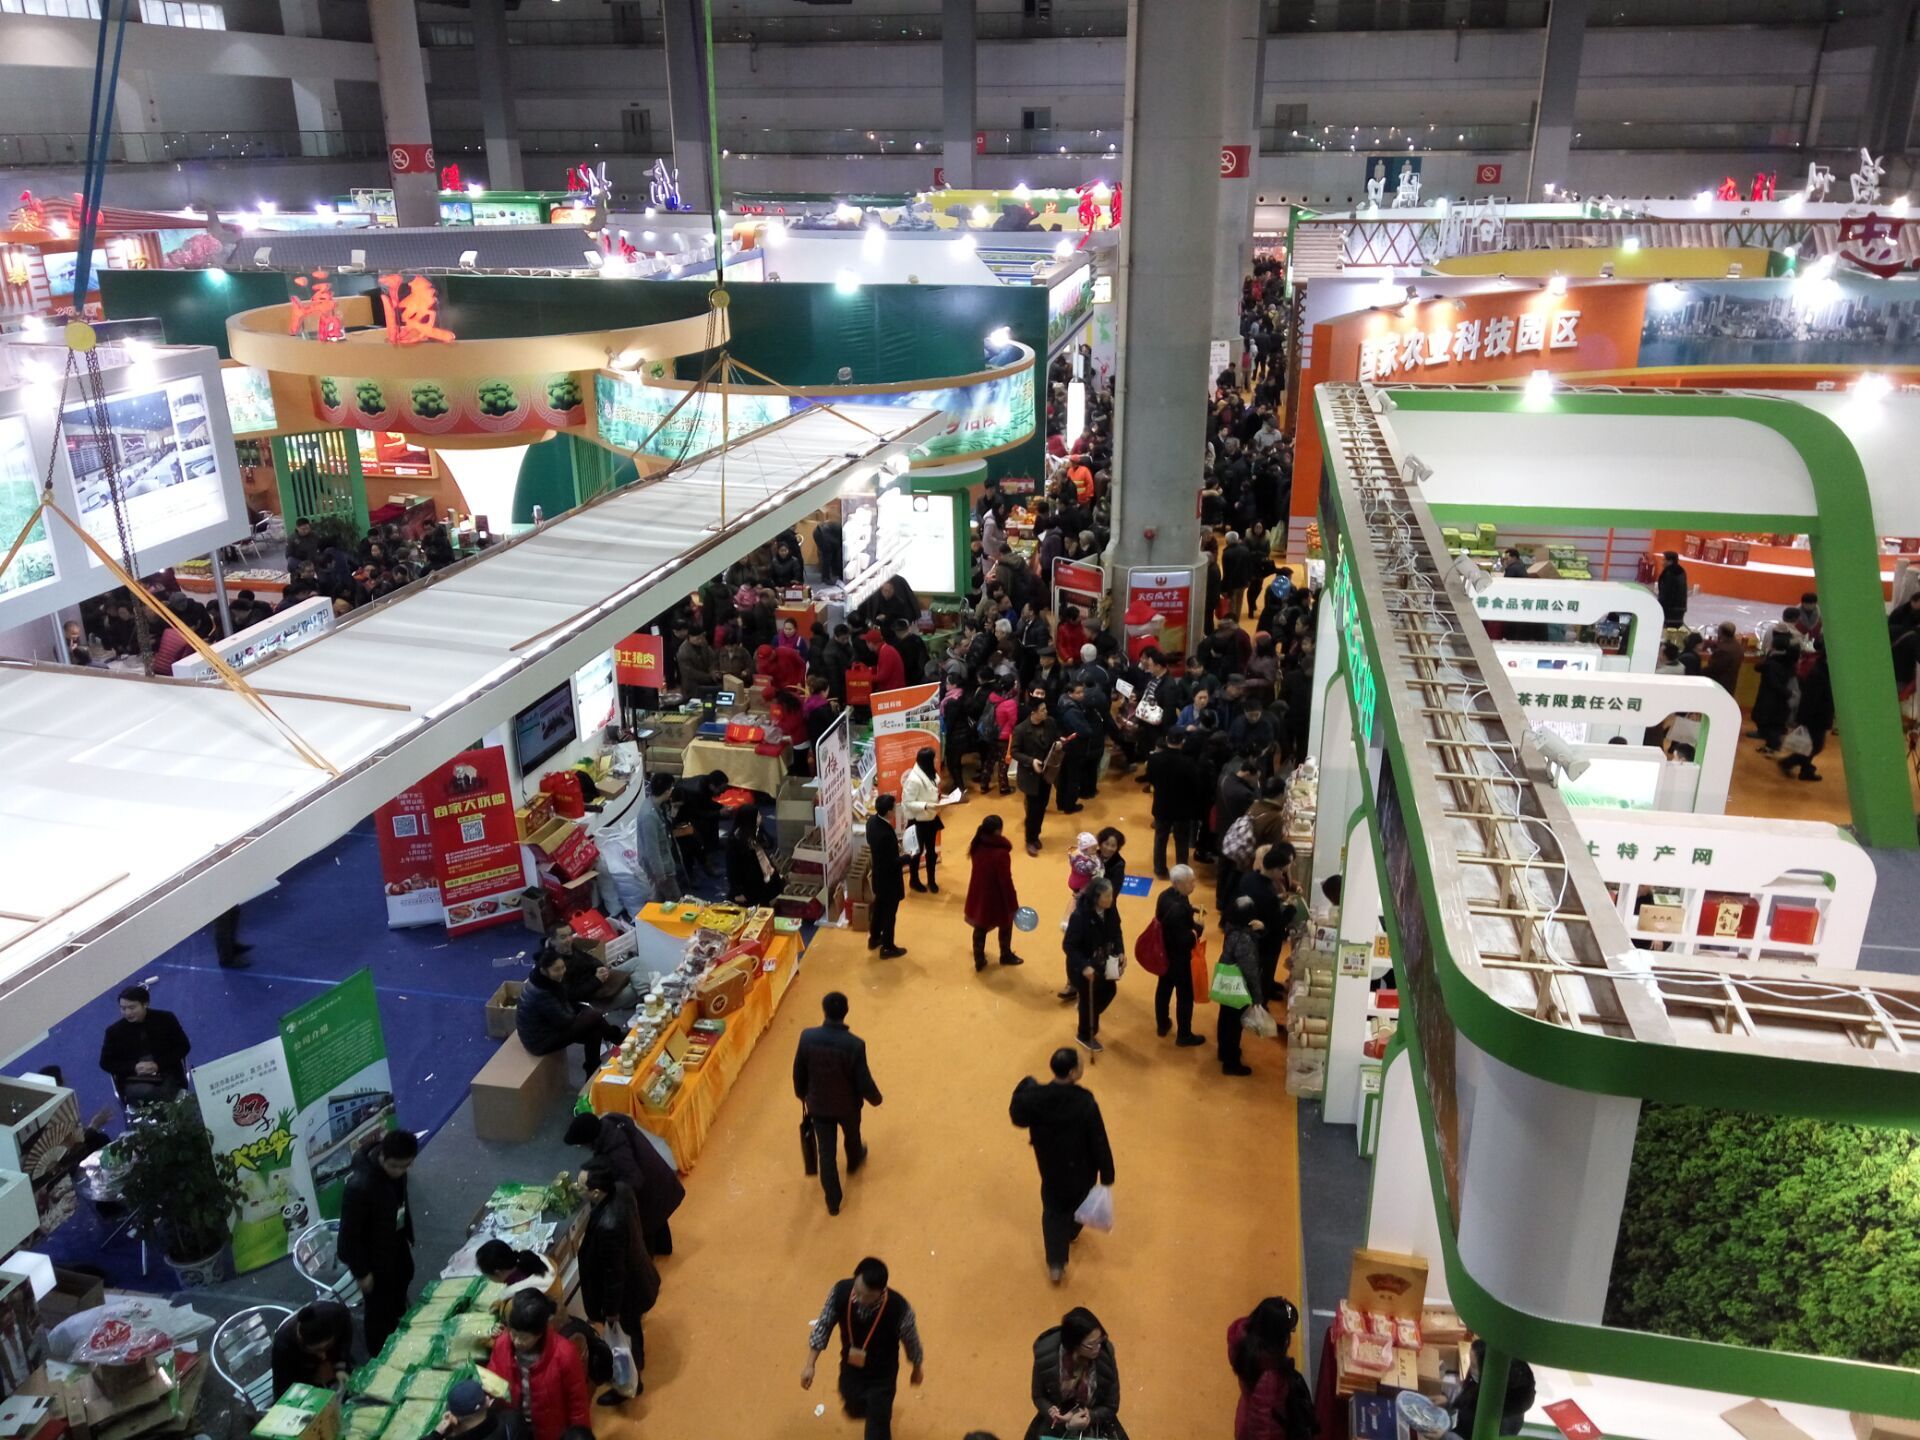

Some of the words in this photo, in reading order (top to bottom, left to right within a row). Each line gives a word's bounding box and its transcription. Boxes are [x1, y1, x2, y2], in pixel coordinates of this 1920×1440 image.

[1359, 311, 1581, 382] 国家农业科技园区
[1517, 692, 1643, 712] 茶有限责任公司
[433, 793, 506, 819] 商家大联盟
